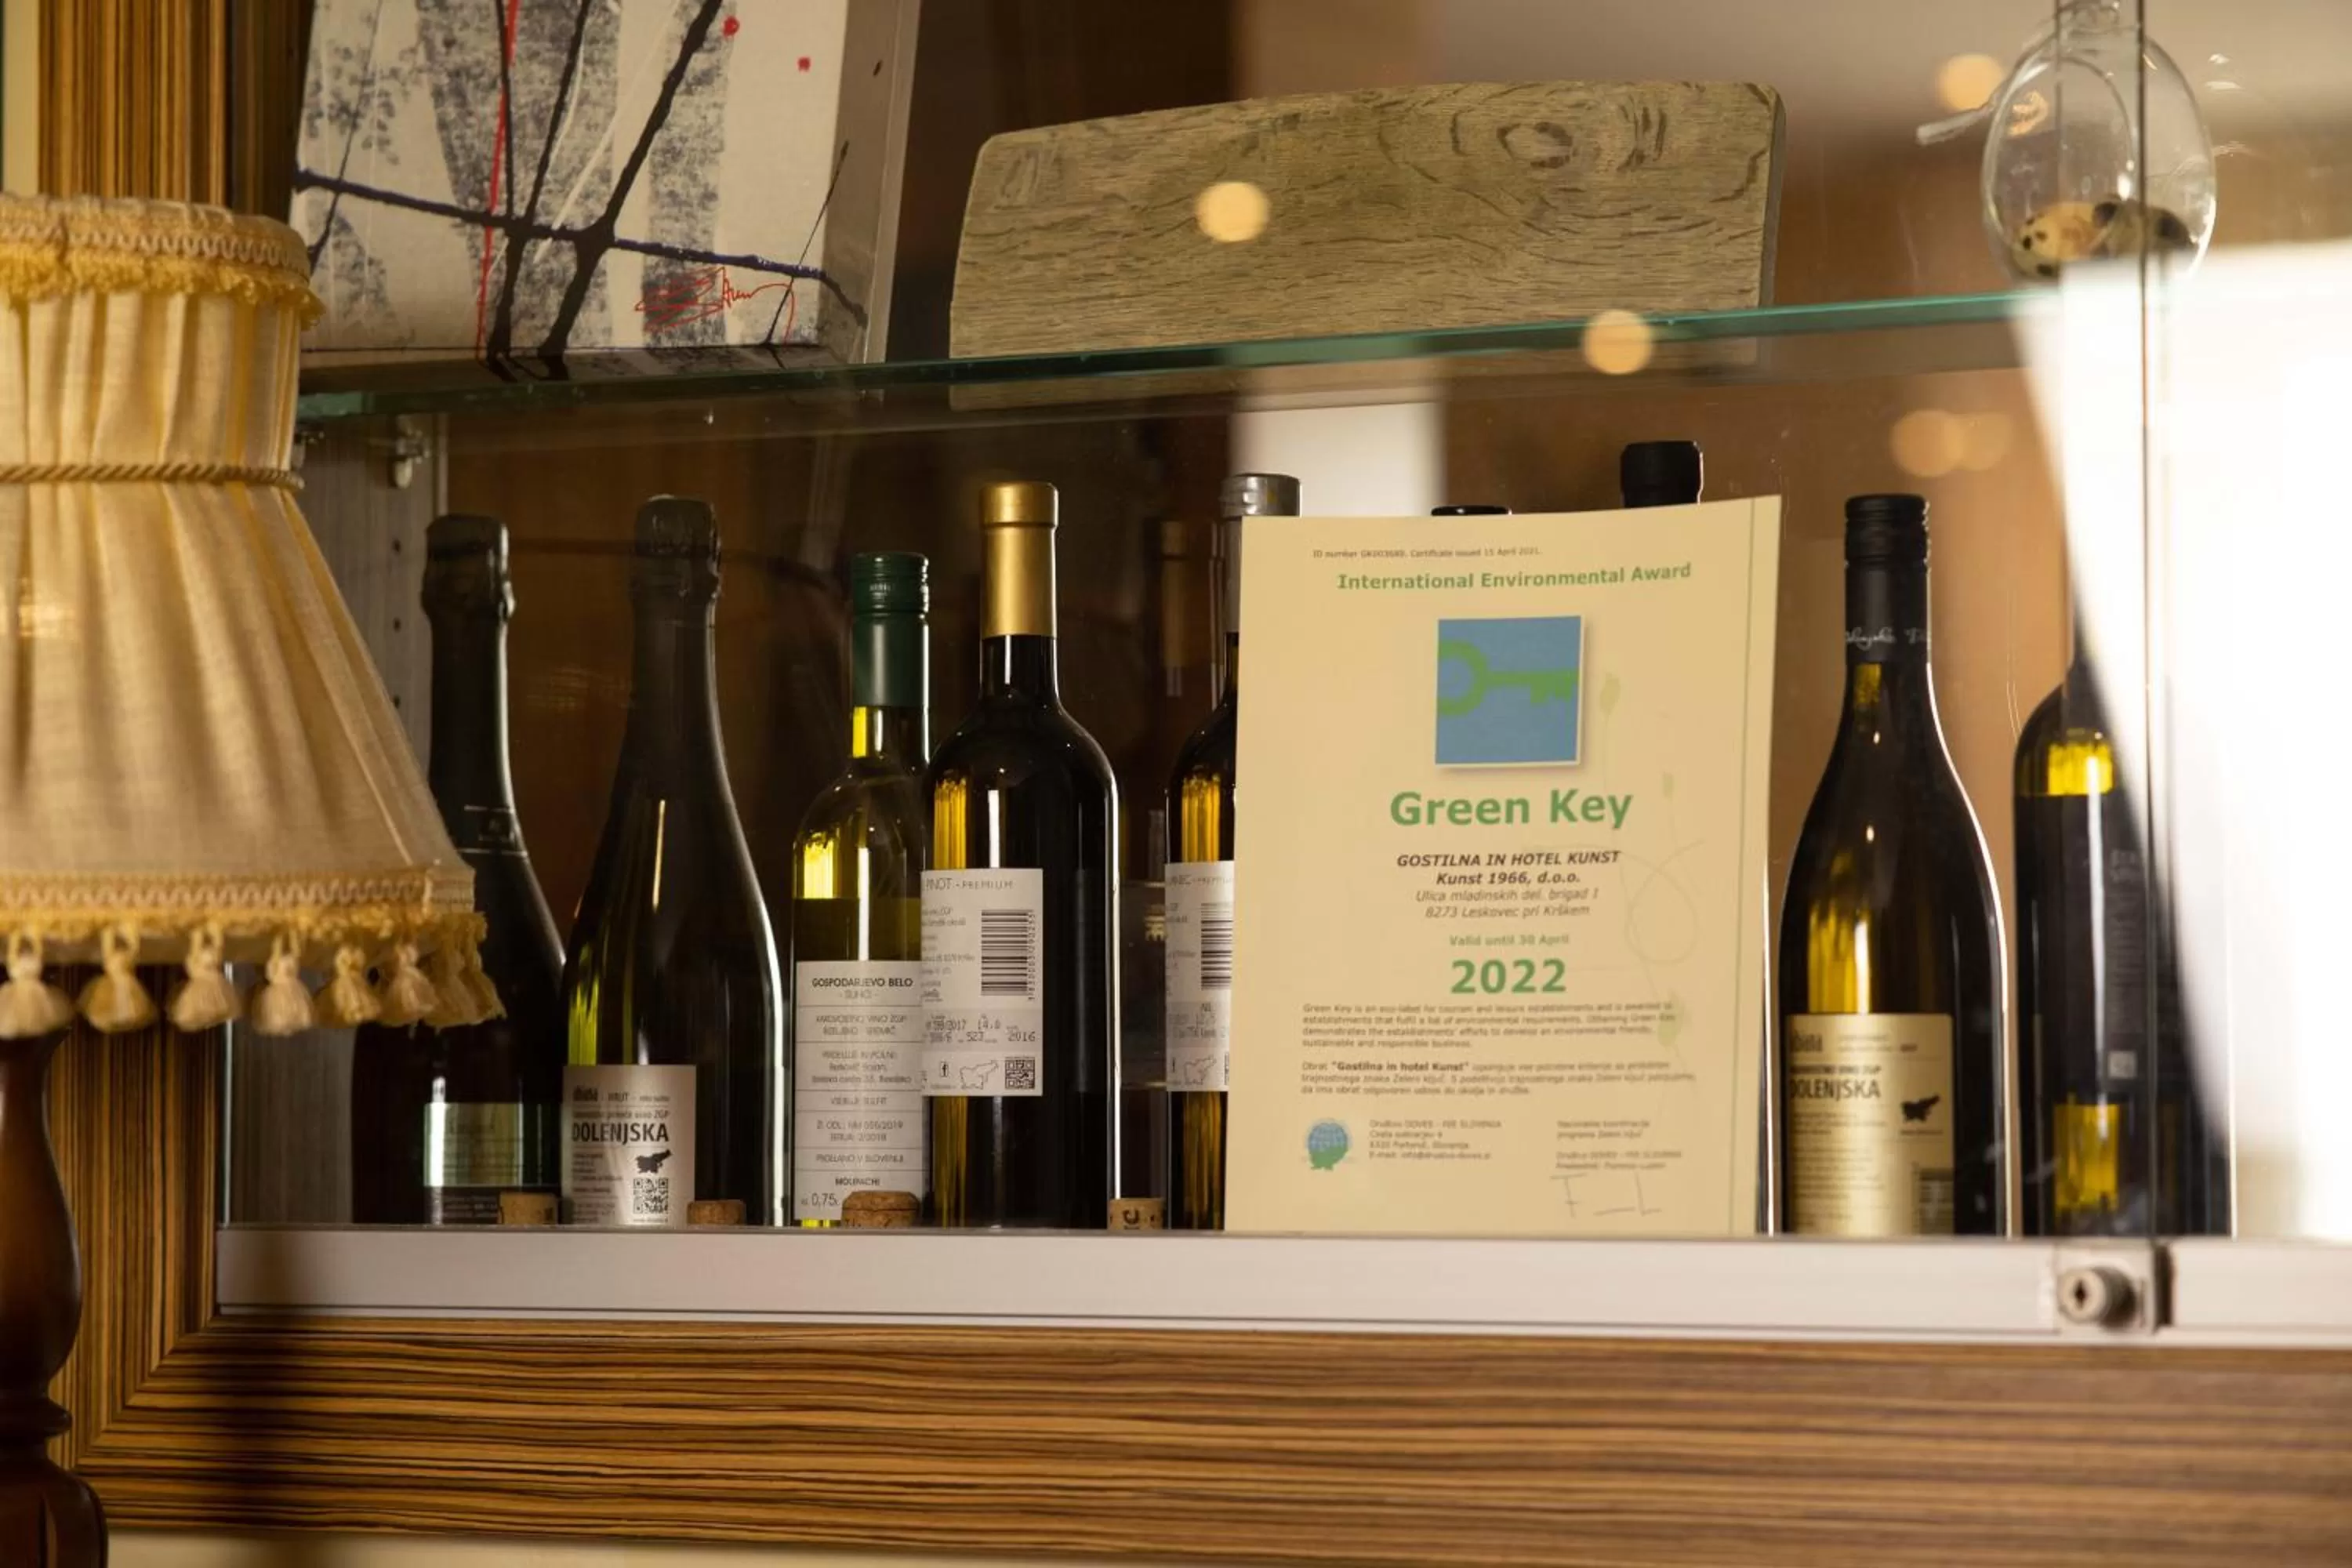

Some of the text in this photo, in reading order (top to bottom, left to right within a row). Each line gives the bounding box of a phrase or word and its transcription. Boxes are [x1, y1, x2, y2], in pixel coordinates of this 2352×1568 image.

[1336, 562, 1692, 590] International Environmental Award
[1391, 788, 1634, 830] Green Key
[1396, 851, 1622, 867] GOSTILNA IN HOTEL KUNST
[1436, 869, 1581, 887] Kunst 1966, d.o.o.
[1415, 890, 1446, 902] Ulica
[1450, 888, 1518, 902] mladinskih
[1548, 887, 1588, 903] brigad
[1425, 906, 1457, 919] 8273
[1461, 906, 1519, 918] Leskovec
[1522, 906, 1540, 920] pri
[1450, 935, 1481, 946] Valid
[1485, 935, 1515, 946] until
[1539, 934, 1569, 948] April
[811, 977, 913, 988] GOSPODARJEVO BELO
[1450, 957, 1567, 995] 2022
[1007, 1031, 1036, 1042] 2016
[572, 1122, 670, 1145] DOLENJSKA
